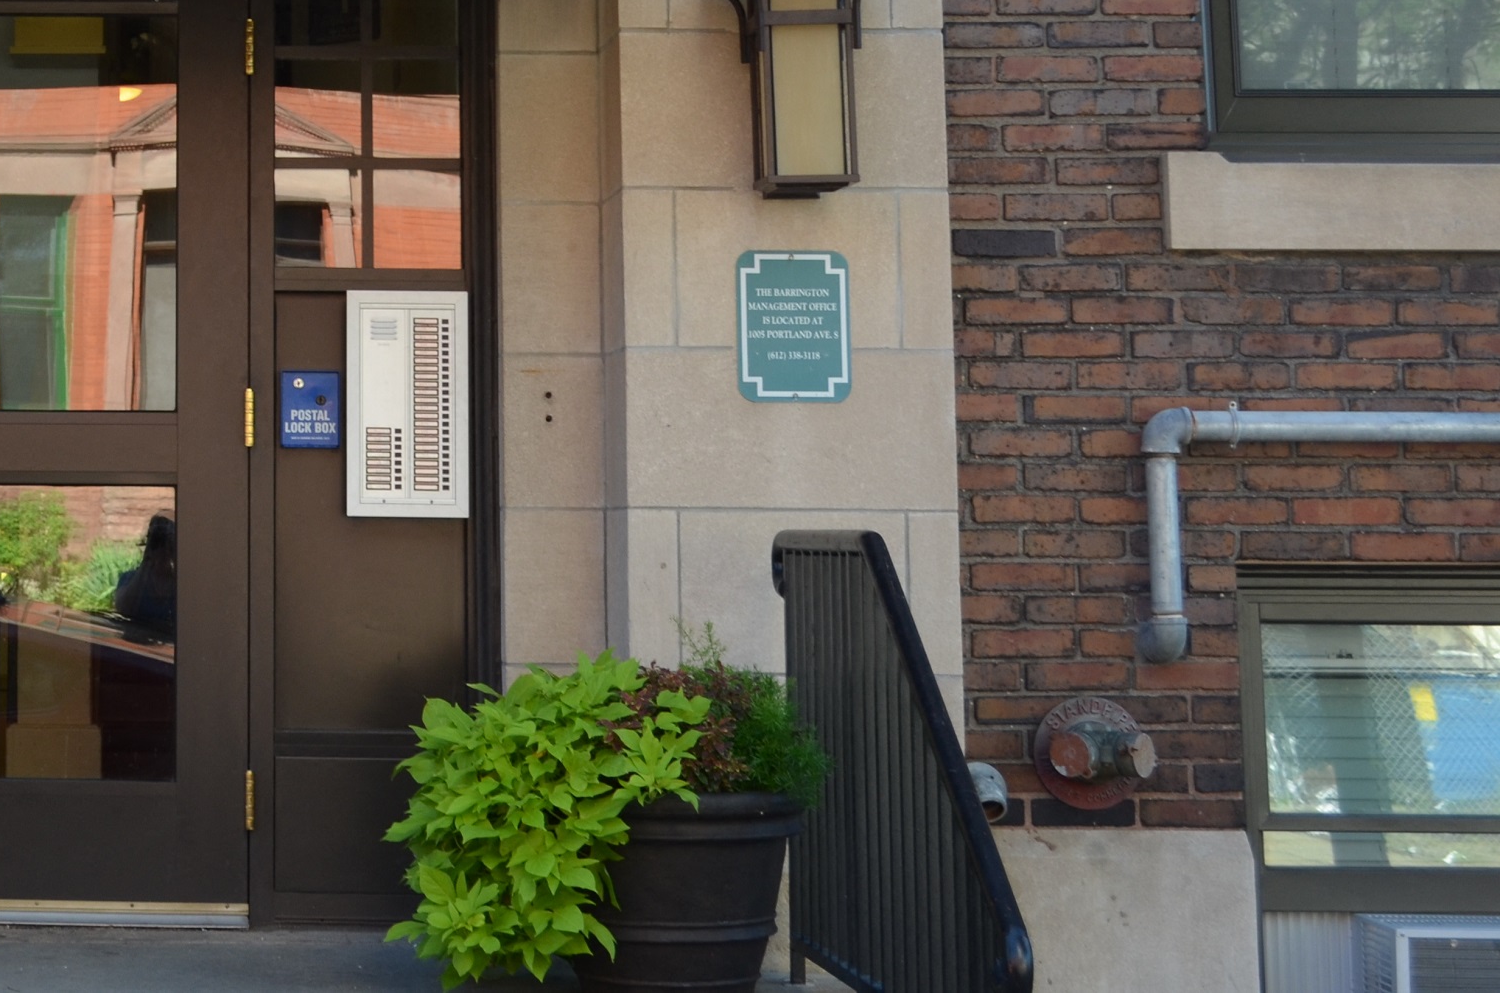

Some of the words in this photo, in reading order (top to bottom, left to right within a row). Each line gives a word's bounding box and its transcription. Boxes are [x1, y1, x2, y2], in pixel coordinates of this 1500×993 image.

[756, 288, 773, 297] THE
[773, 288, 829, 298] BARRINGTON
[748, 302, 807, 311] MANAGEMENT
[808, 302, 838, 311] OFFICE
[762, 316, 771, 325] IS
[771, 316, 810, 325] LOCATED
[811, 316, 824, 325] AT
[766, 330, 812, 339] PORTLAND
[833, 331, 839, 339] S
[767, 351, 787, 360] (612)
[290, 409, 331, 422] POSTAL
[284, 422, 312, 434] LOCK
[314, 422, 336, 434] BOX
[1046, 699, 1137, 733] STANDPIPE
